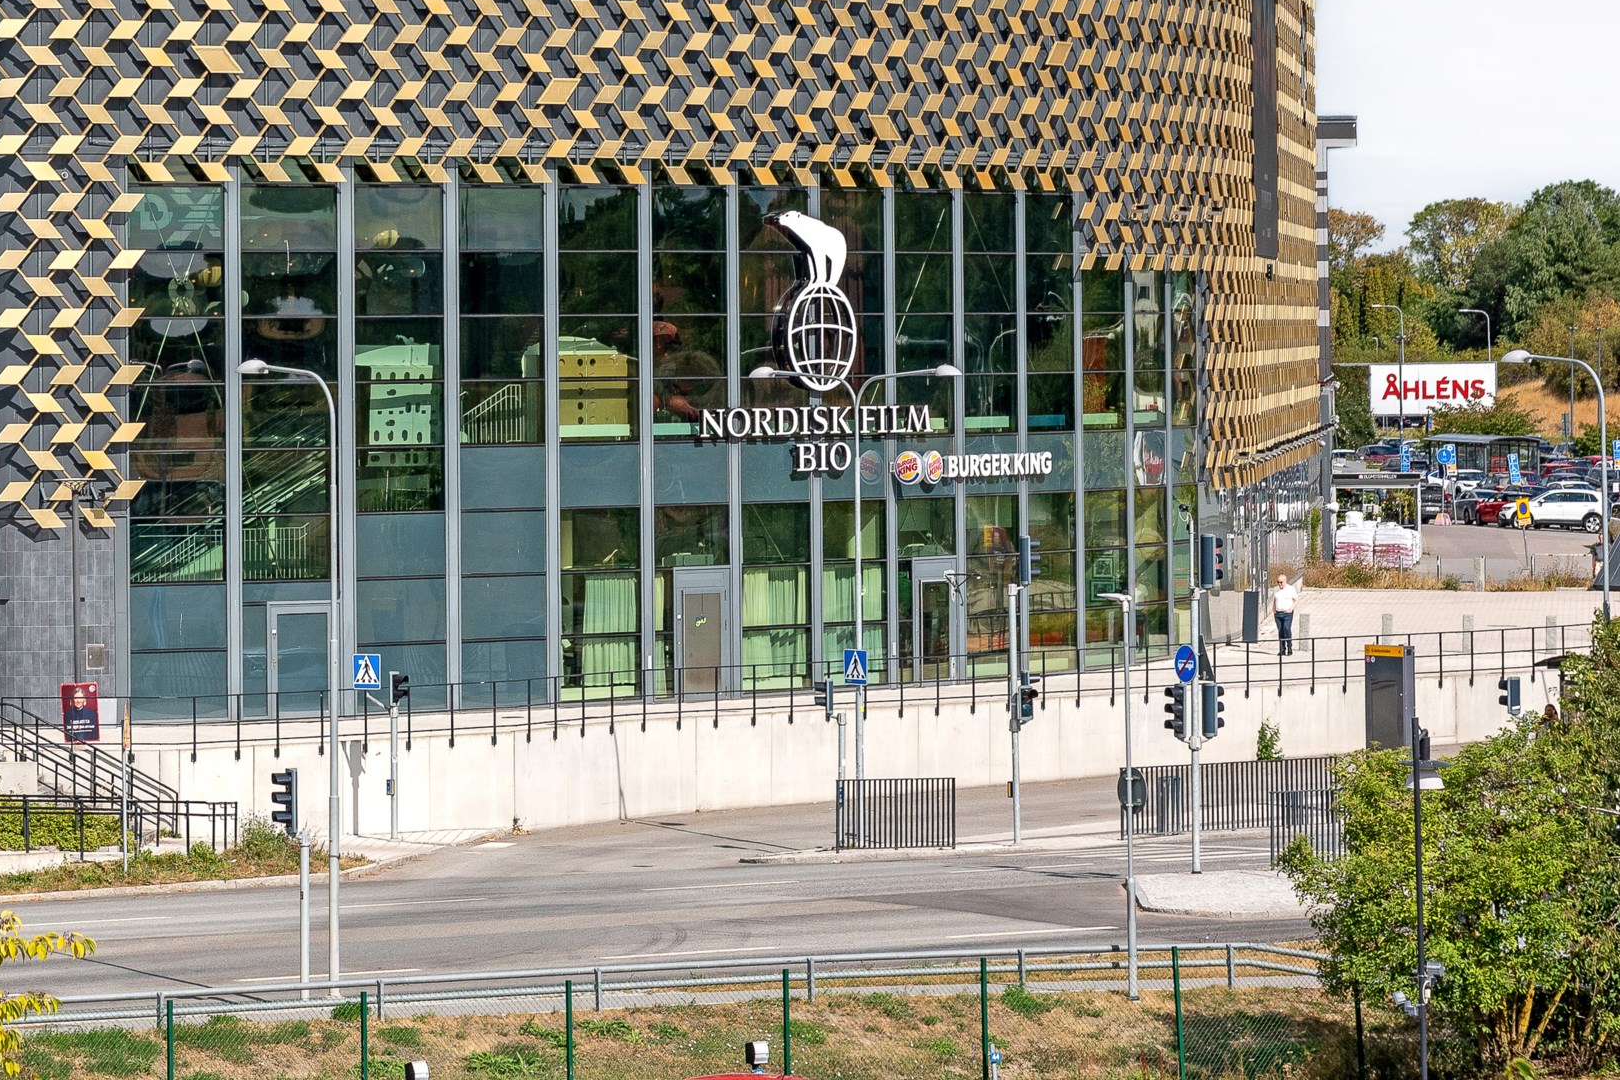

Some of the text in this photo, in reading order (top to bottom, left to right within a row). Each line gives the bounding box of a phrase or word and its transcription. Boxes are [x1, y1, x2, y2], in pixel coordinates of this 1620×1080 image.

[135, 187, 220, 246] DX
[1382, 373, 1485, 400] ÅHLÉNS
[700, 404, 933, 437] NORDISK FILM
[795, 441, 852, 472] BIO
[897, 458, 917, 469] BURGER
[897, 463, 918, 476] KING
[948, 451, 1052, 477] BURGER KING
